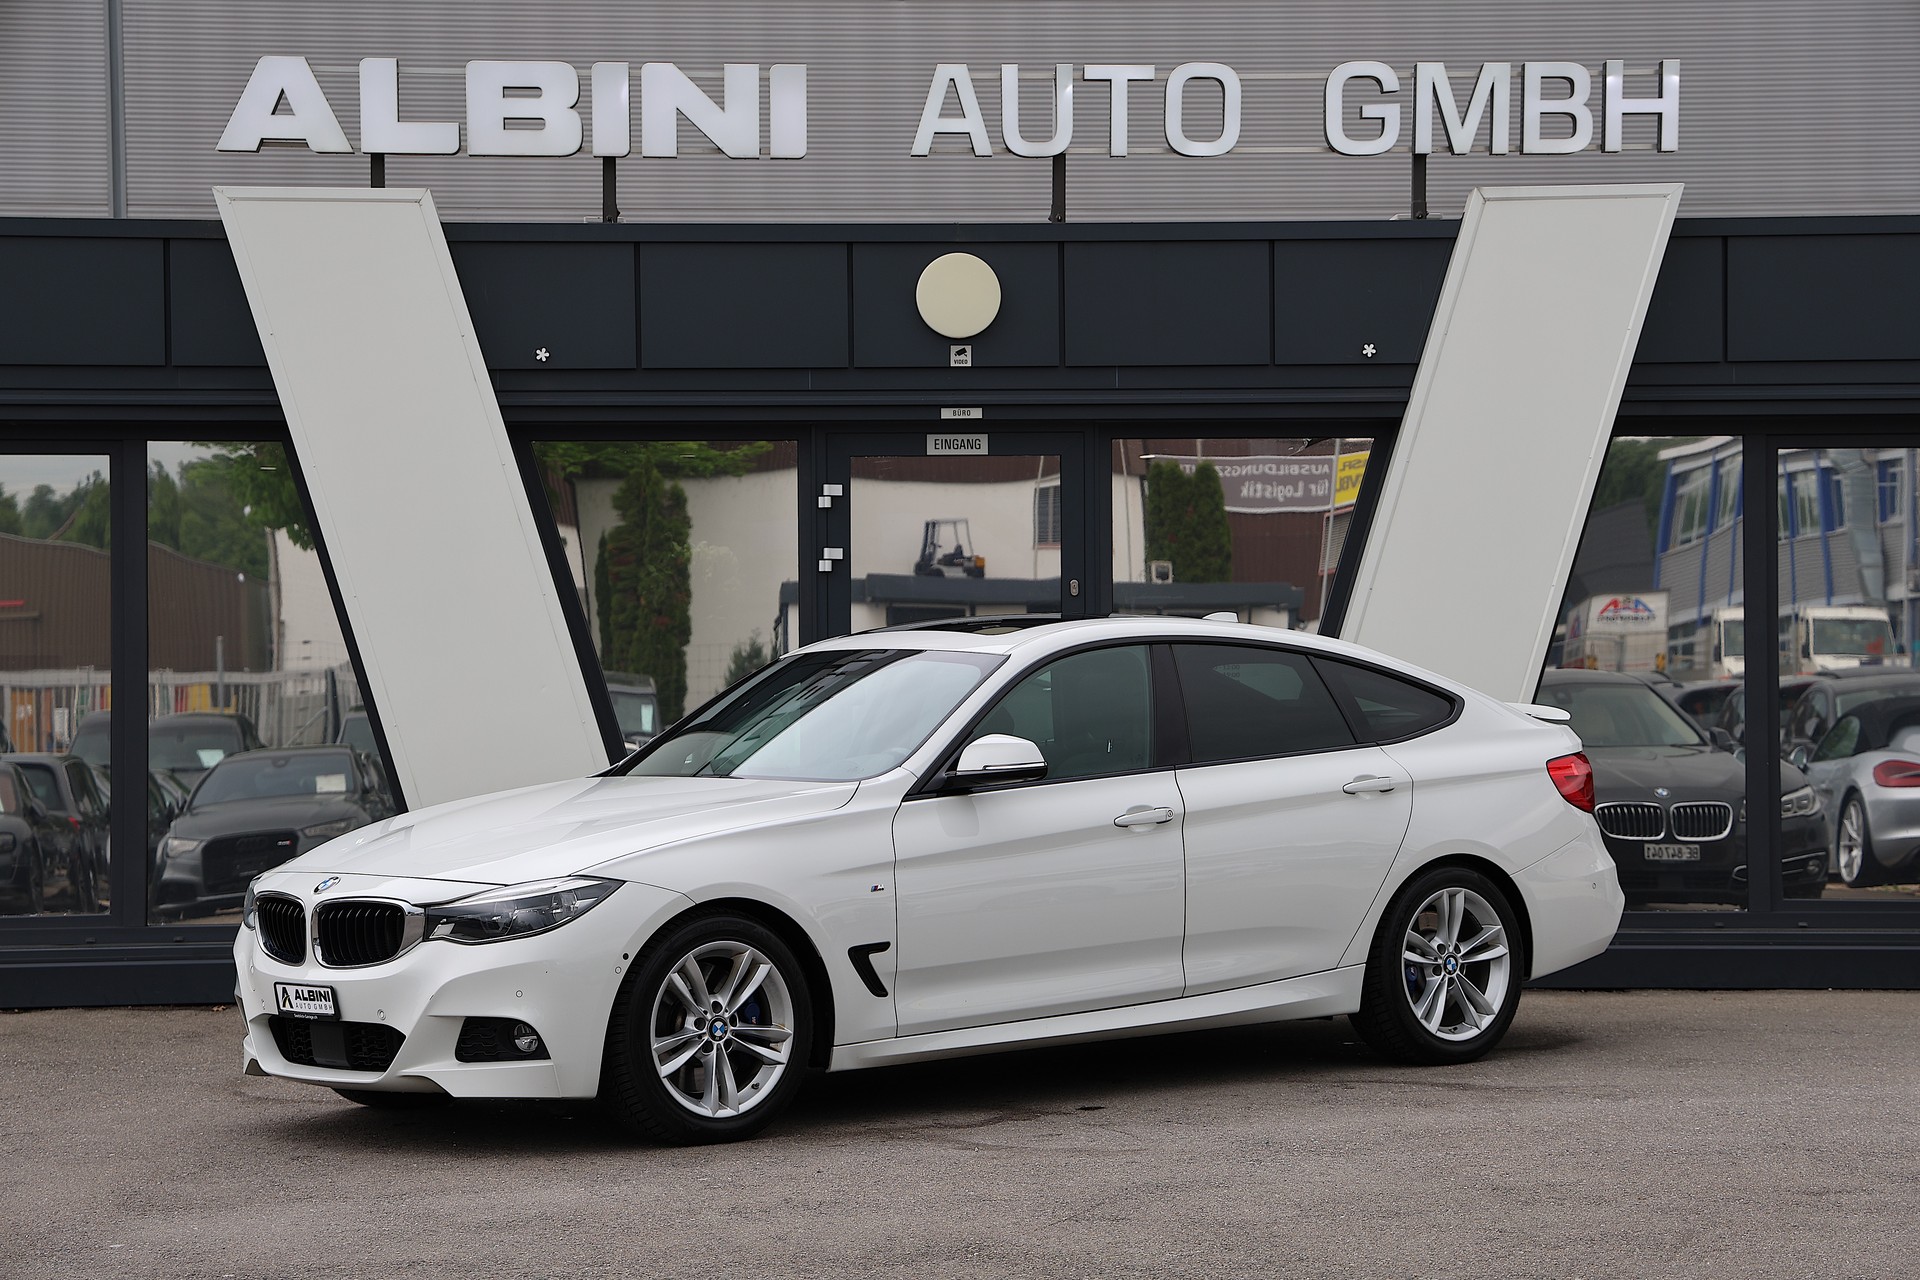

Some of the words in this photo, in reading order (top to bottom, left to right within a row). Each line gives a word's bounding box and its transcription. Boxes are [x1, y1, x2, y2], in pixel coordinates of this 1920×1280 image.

[215, 56, 808, 159] ALBINI
[910, 62, 1242, 158] AUTO
[1324, 60, 1681, 155] GMBH
[952, 409, 971, 417] BÜRO
[934, 438, 981, 450] EINGANG
[295, 988, 331, 1002] ALBINI
[295, 1002, 311, 1010] AUTO
[313, 1003, 333, 1011] GMBH
